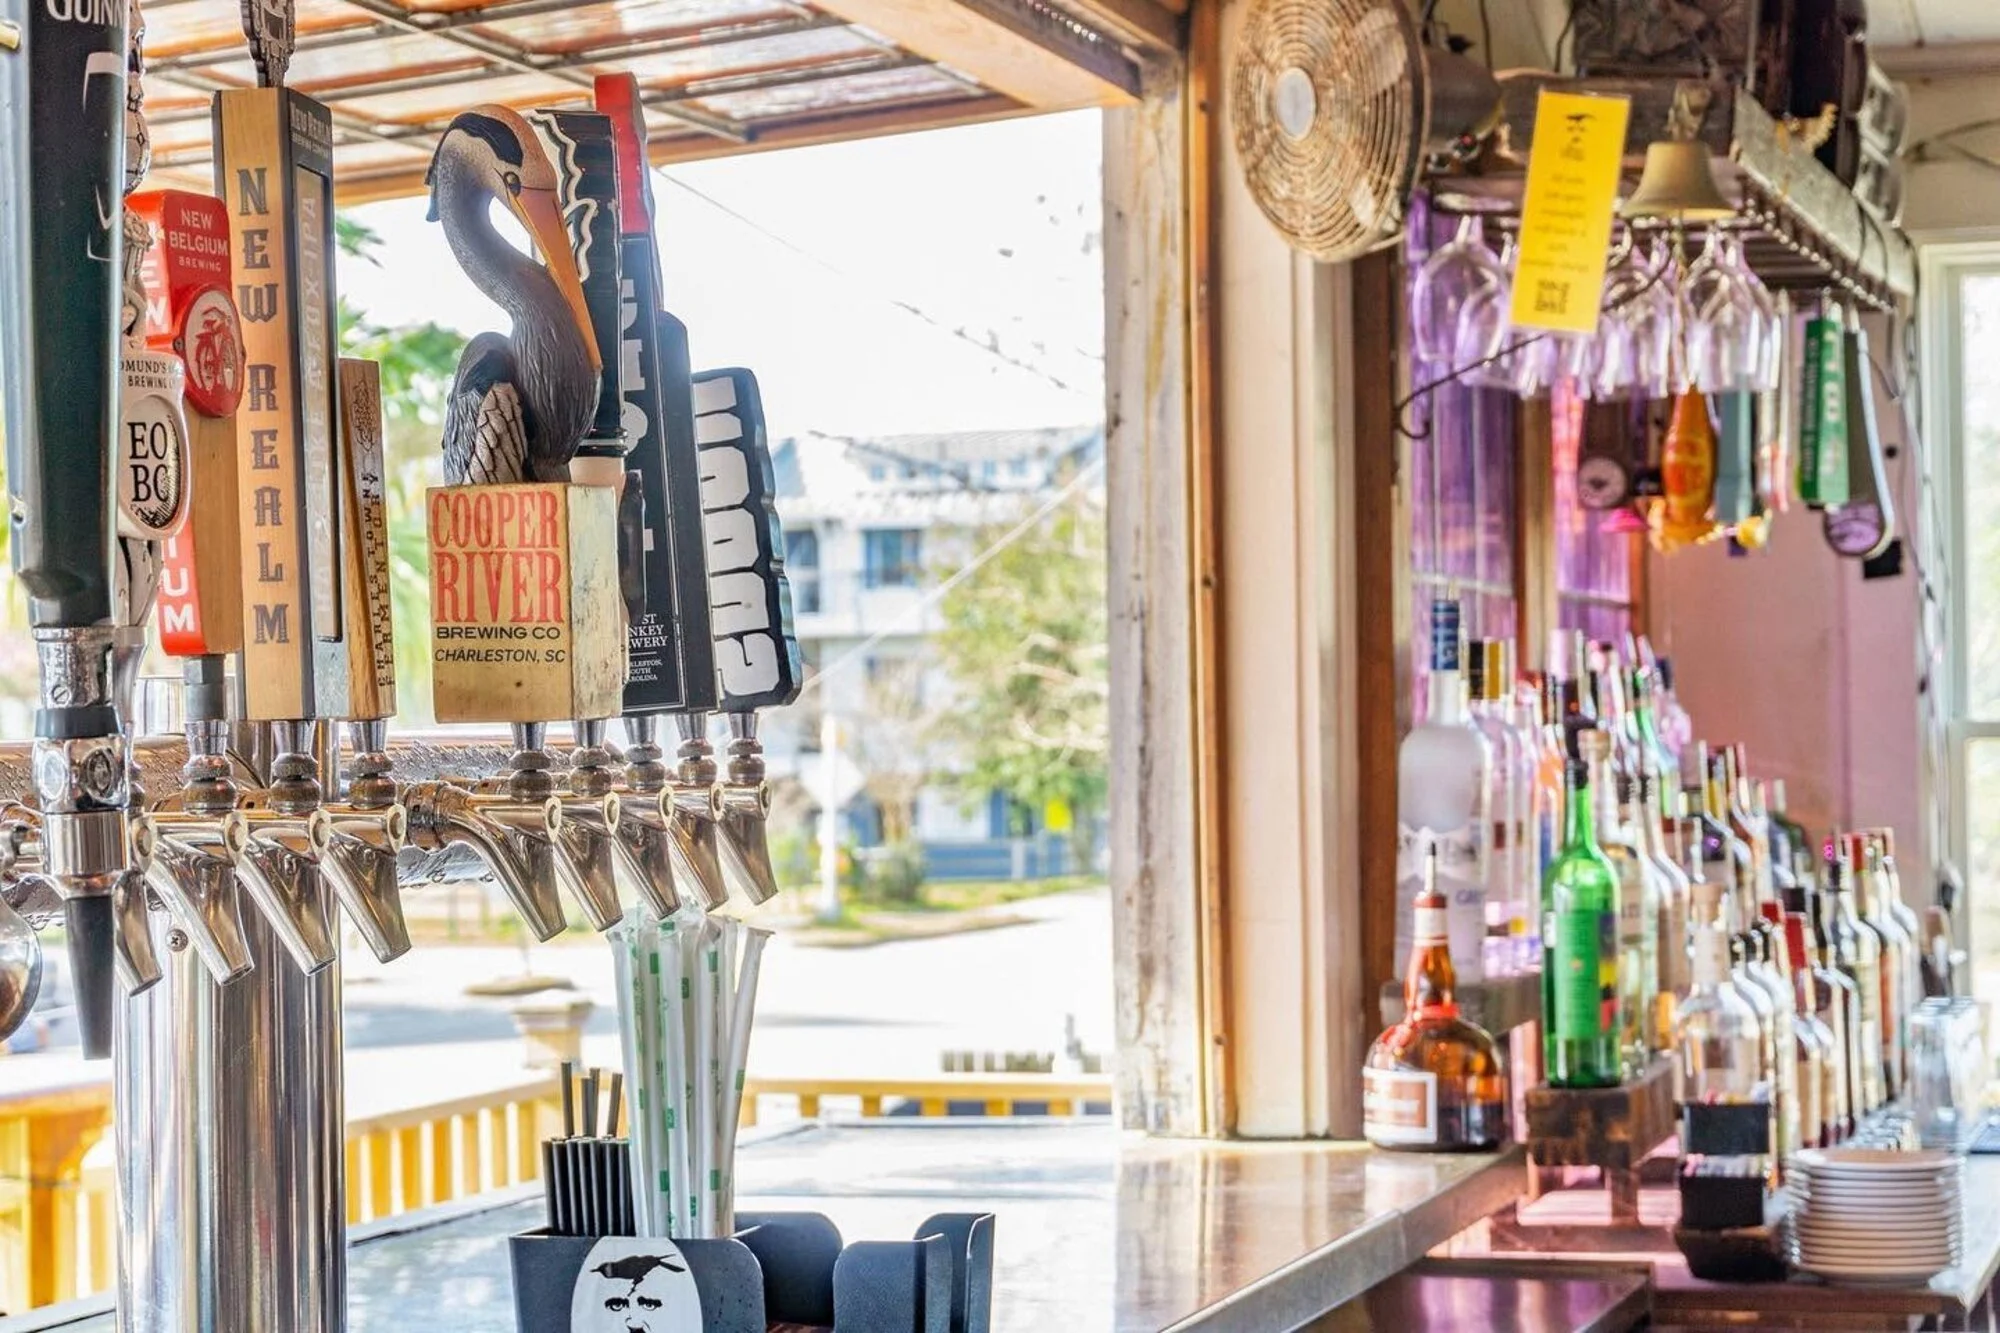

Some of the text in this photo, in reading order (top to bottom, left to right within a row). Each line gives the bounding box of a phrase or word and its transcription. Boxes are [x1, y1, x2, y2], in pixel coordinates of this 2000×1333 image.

[181, 209, 212, 228] NEW
[169, 231, 228, 256] BELGIUM
[179, 256, 221, 271] BREWING
[237, 168, 289, 643] NEW REALM
[127, 422, 168, 460] EO
[432, 491, 559, 548] COOPER
[362, 473, 386, 686] CHARLES TOWNE
[369, 473, 395, 686] FERMENTORY
[434, 551, 564, 623] RIVER
[437, 626, 560, 639] BREWING CO
[435, 650, 566, 663] CHARLESTON, SC
